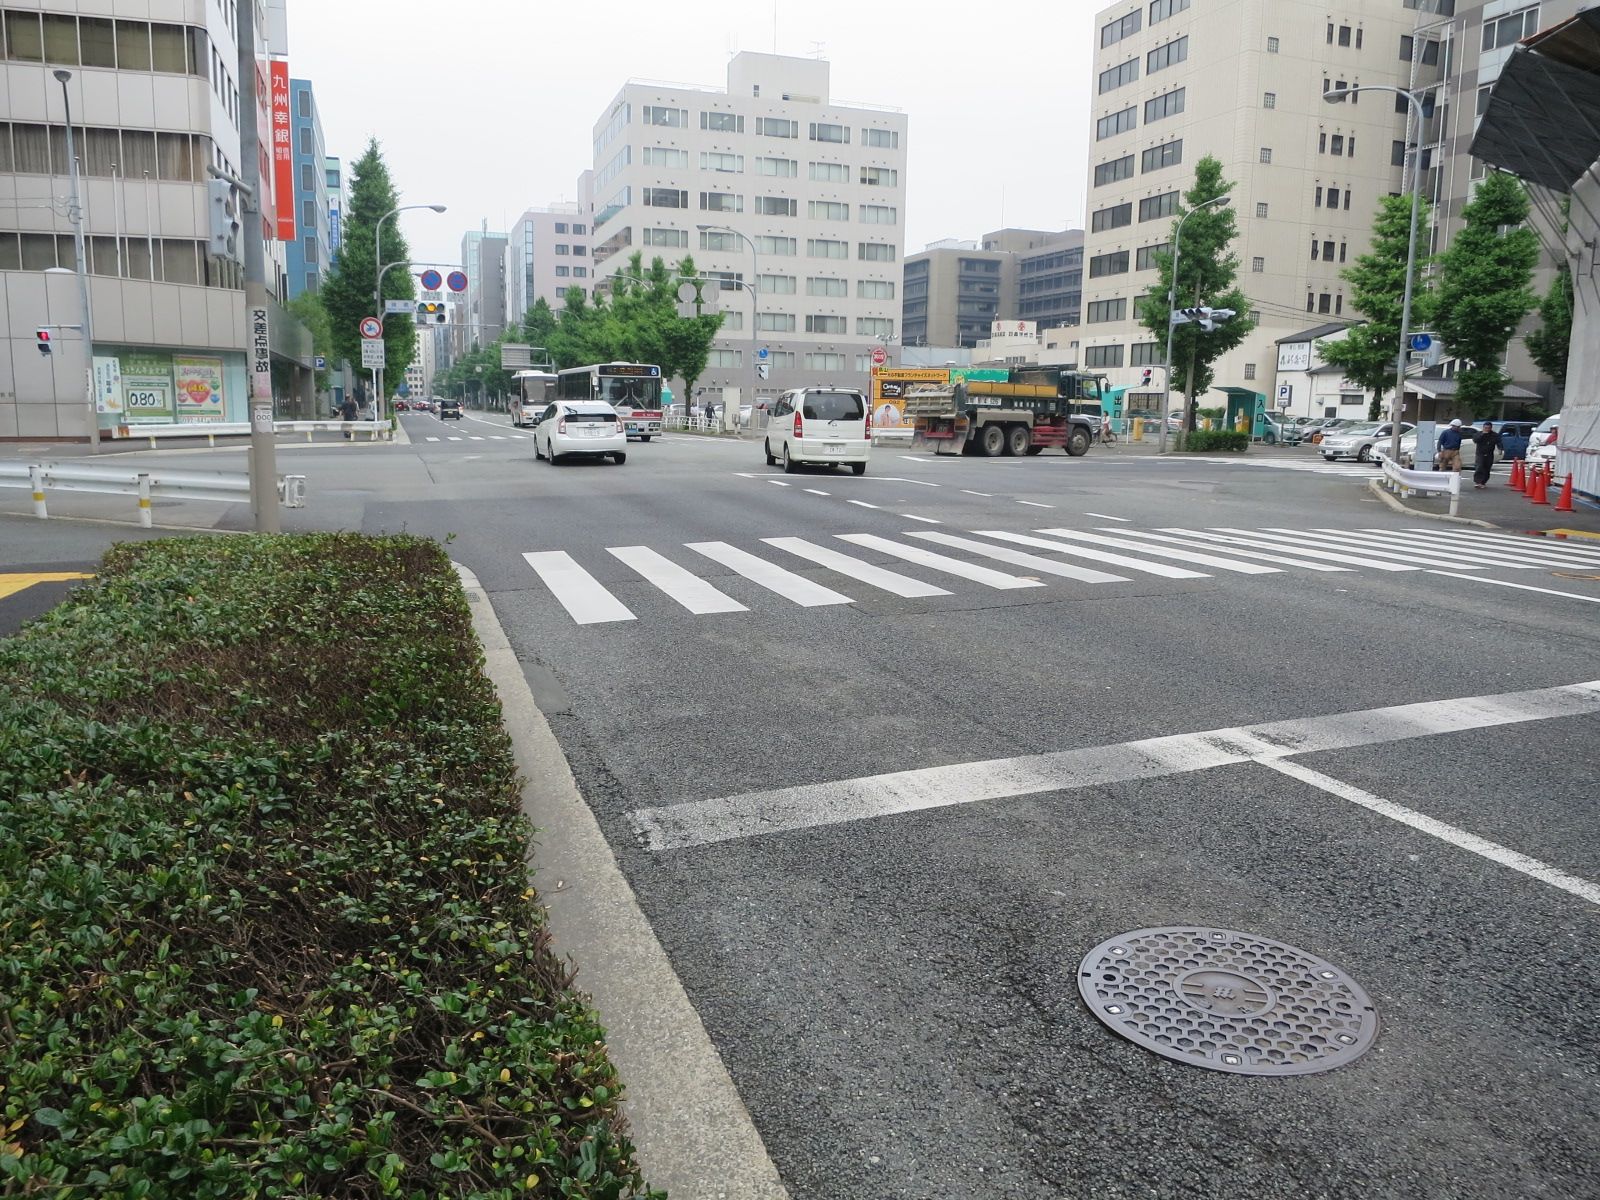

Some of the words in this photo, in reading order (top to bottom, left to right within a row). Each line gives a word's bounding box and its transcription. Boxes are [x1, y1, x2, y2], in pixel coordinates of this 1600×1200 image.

[273, 74, 289, 143] 九州幸銀
[253, 309, 269, 373] 交差点事故
[316, 358, 324, 367] P
[1280, 387, 1287, 397] P
[1257, 399, 1264, 422] 入口
